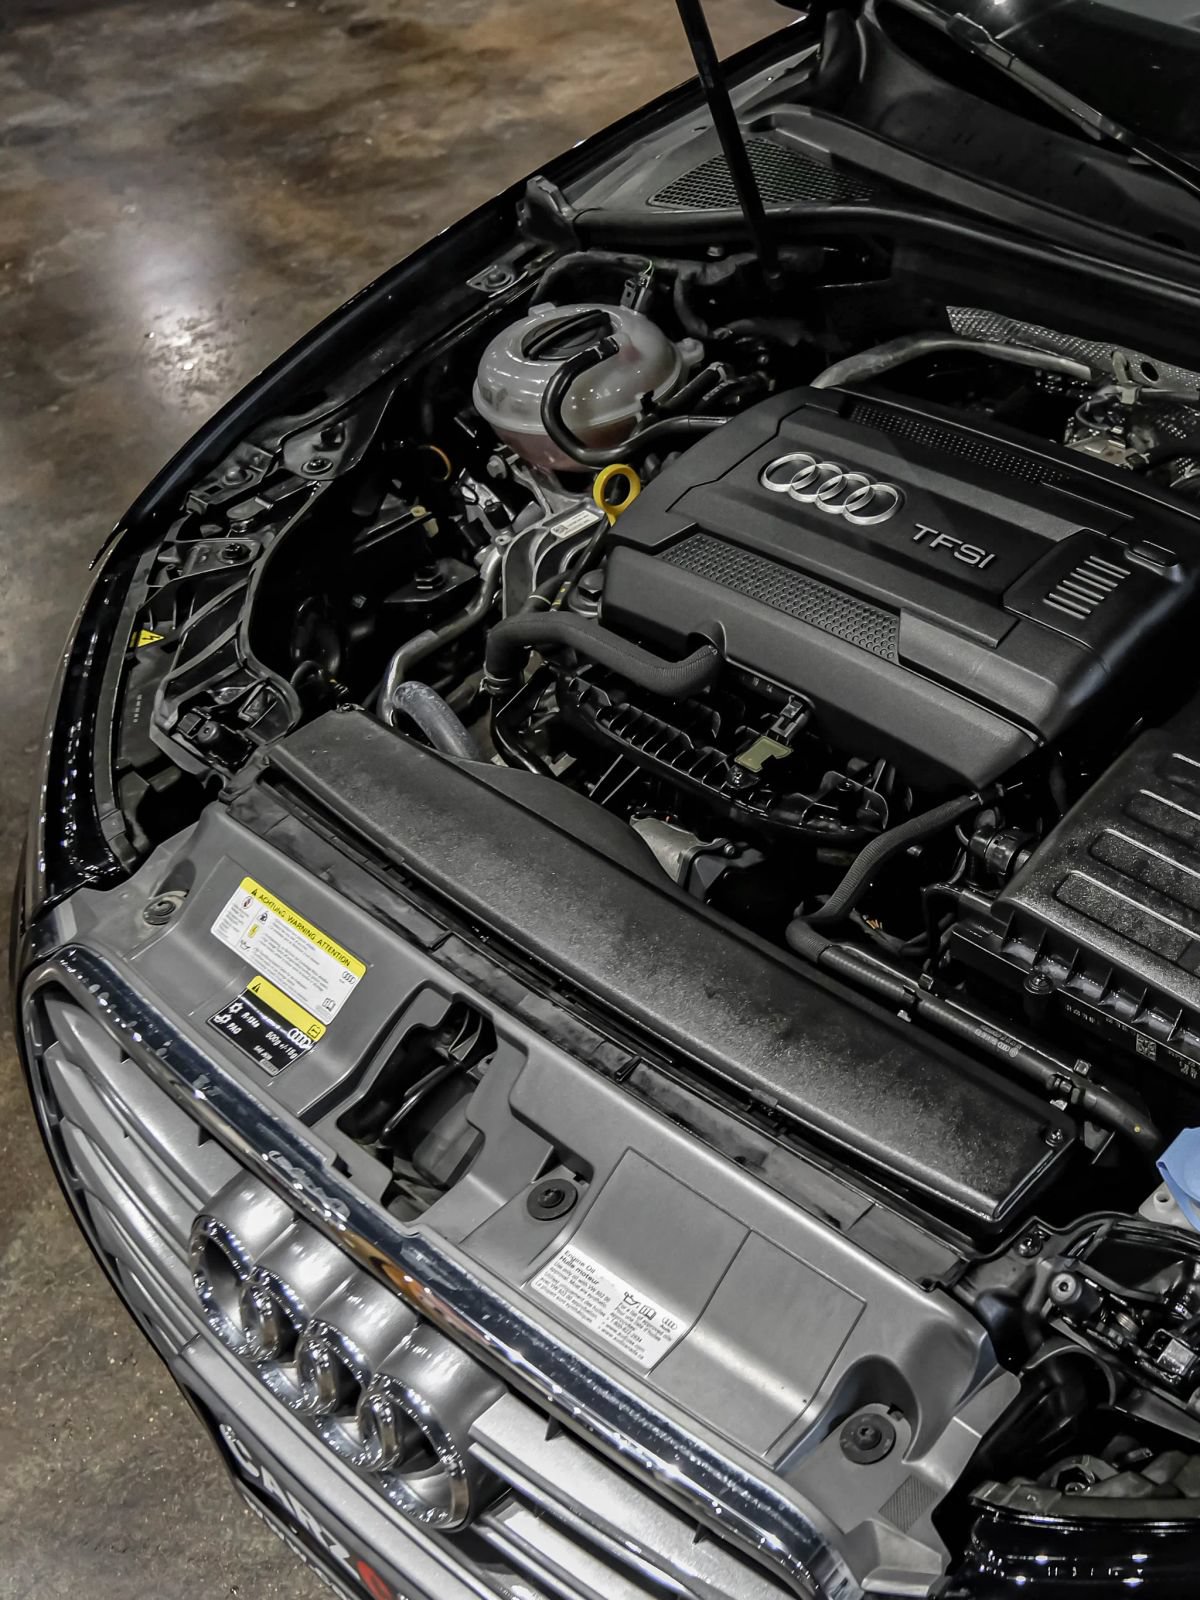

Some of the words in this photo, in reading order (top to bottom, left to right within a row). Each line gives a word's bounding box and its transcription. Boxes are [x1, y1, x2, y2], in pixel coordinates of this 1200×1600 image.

[912, 522, 996, 569] TFSI
[259, 894, 285, 917] ACHTUNG
[287, 916, 315, 940] WARNING
[317, 938, 351, 966] ATTENTION
[560, 1256, 576, 1269] Huile
[576, 1268, 599, 1286] moteur
[564, 1250, 587, 1268] Engine
[586, 1265, 597, 1274] Oil
